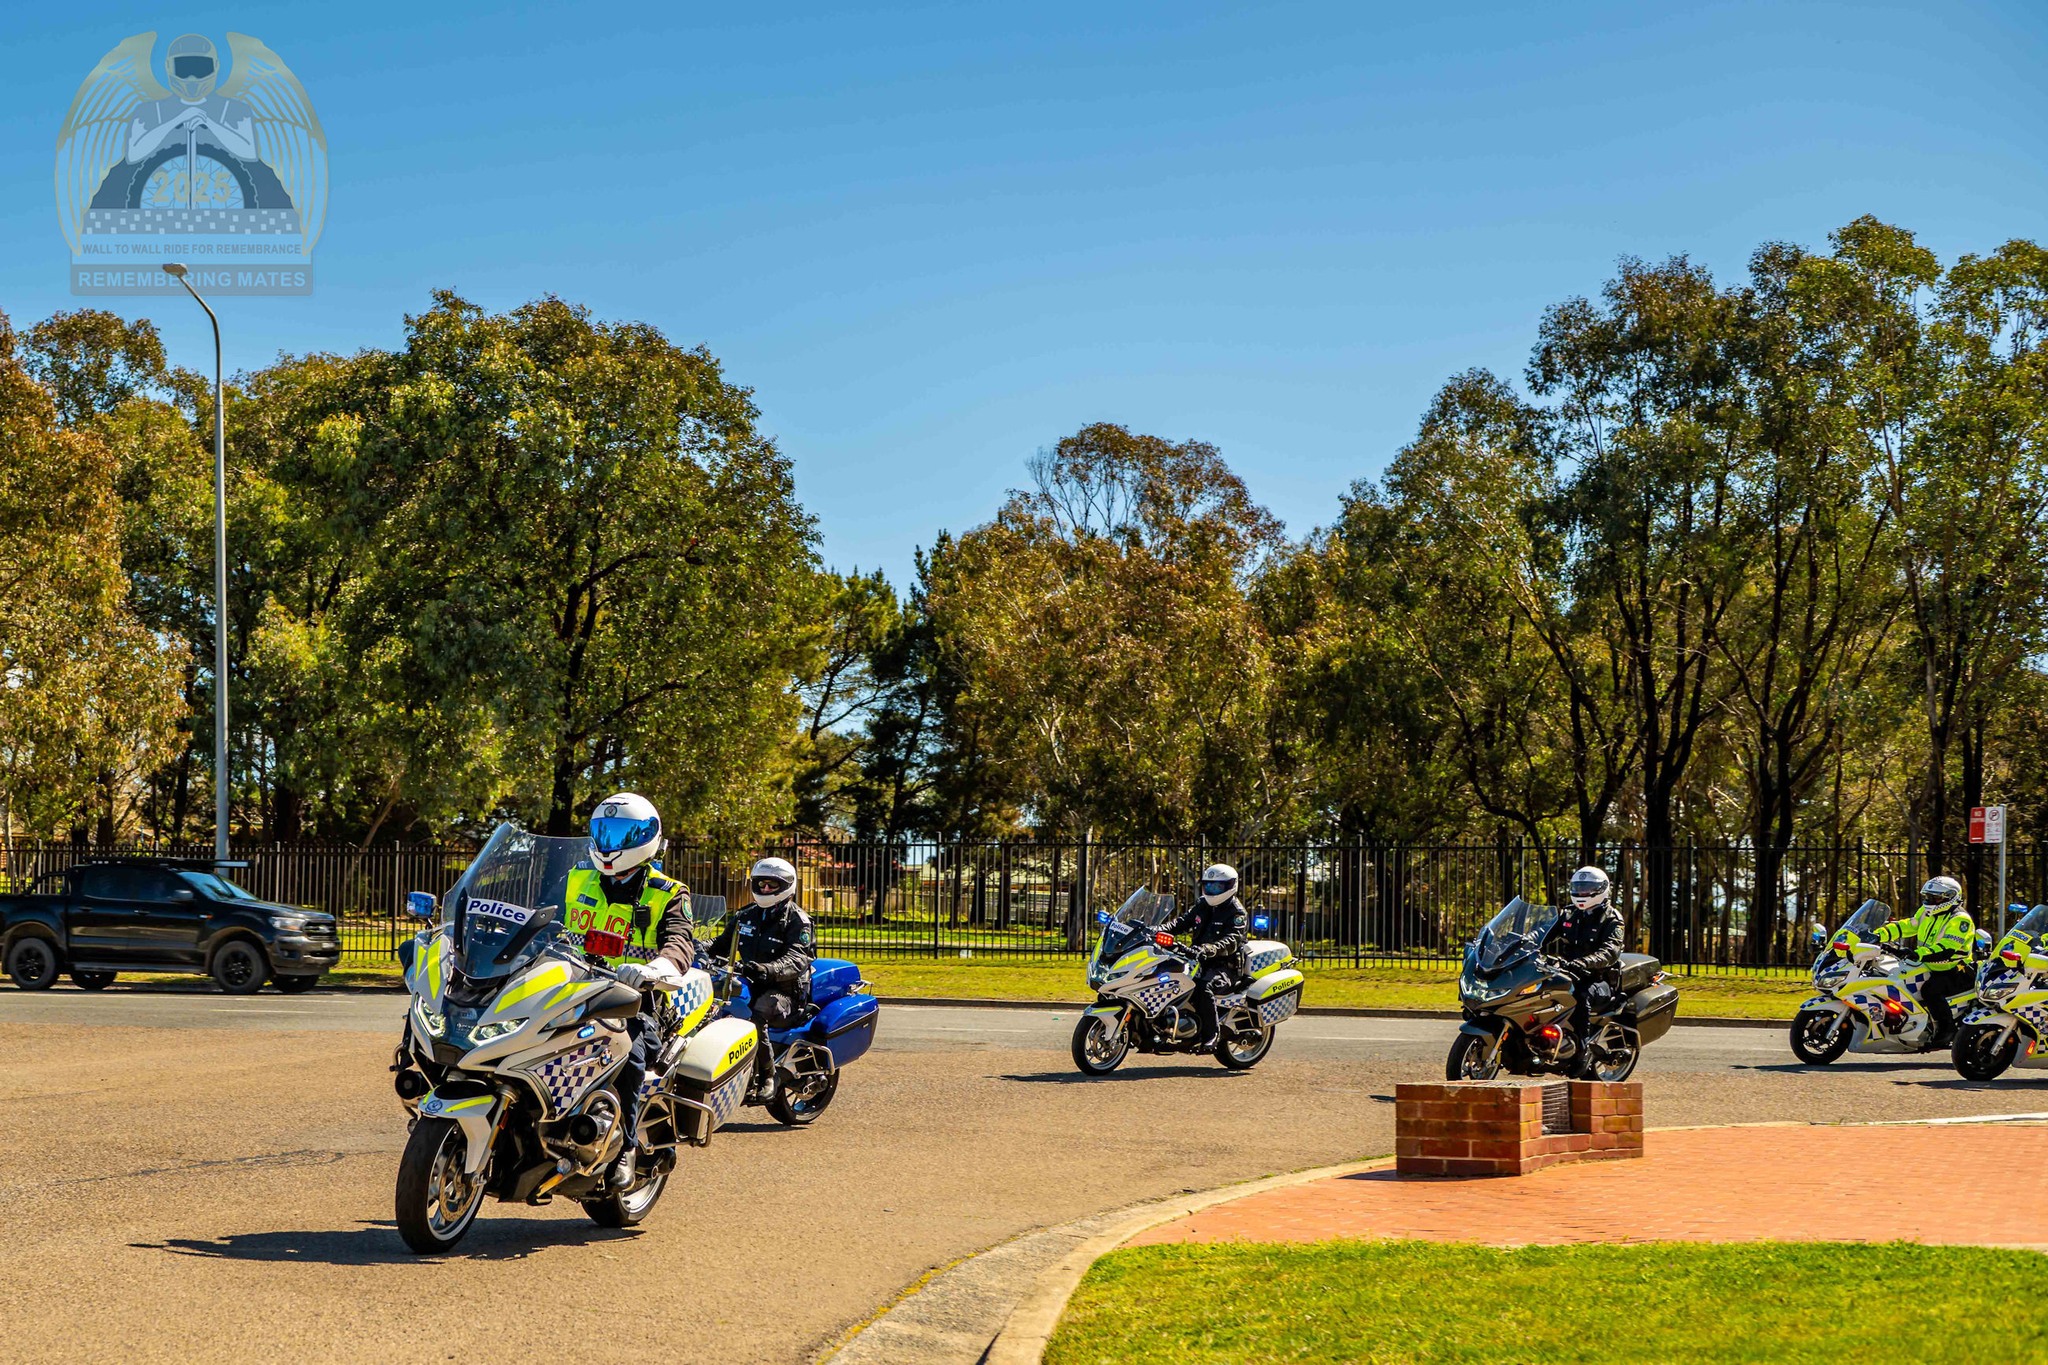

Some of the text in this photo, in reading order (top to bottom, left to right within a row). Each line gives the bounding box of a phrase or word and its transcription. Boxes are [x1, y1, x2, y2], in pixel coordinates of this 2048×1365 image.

[468, 900, 526, 922] Police
[1272, 979, 1295, 993] Police
[728, 1037, 753, 1064] Police
